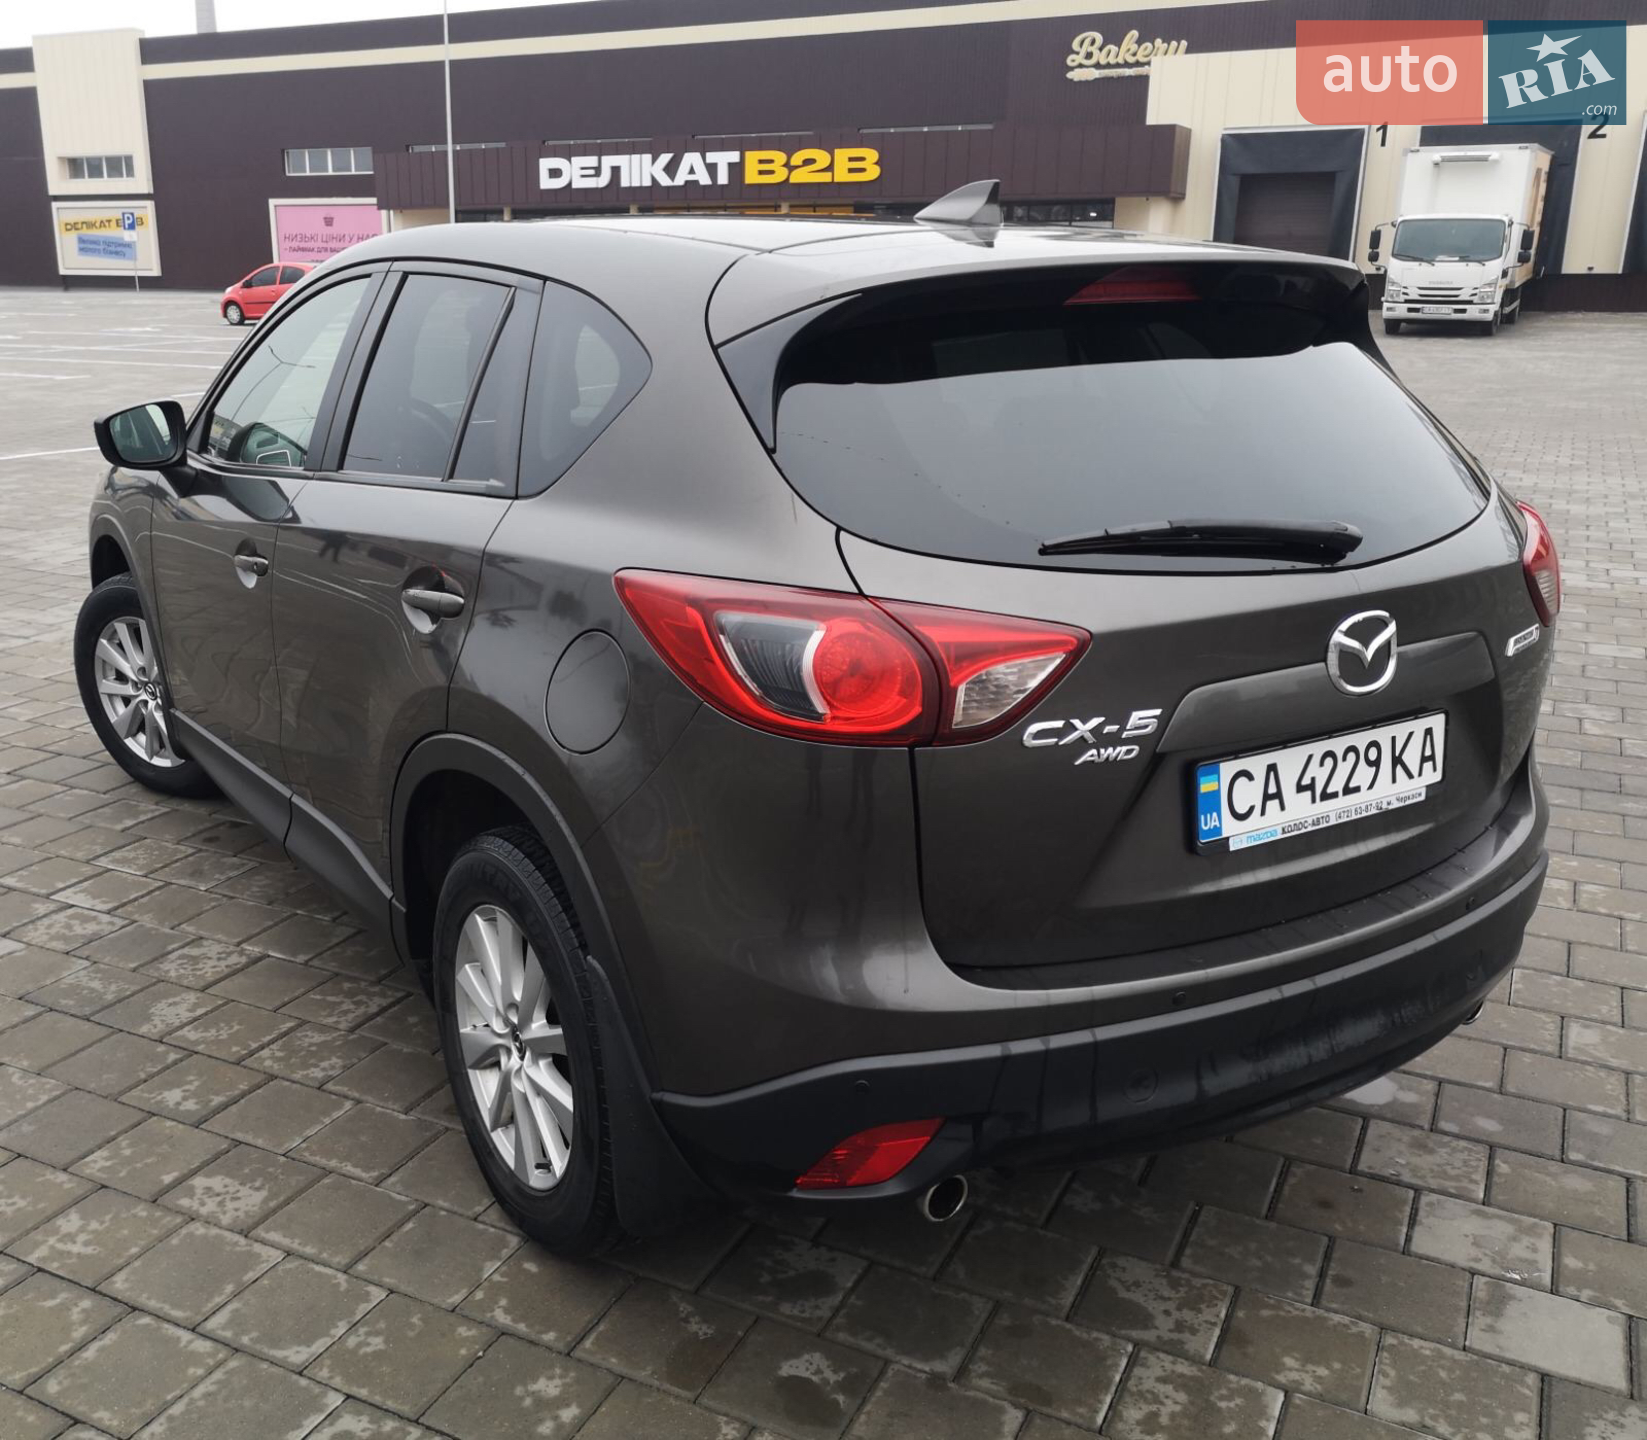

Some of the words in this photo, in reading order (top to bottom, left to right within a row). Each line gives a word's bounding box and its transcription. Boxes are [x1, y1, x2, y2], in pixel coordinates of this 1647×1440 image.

[1375, 121, 1389, 147] 1
[1587, 112, 1610, 140] 2
[744, 147, 881, 184] B2B
[115, 216, 145, 228] BB
[123, 213, 133, 229] P
[283, 232, 319, 244] НИЗЬКІ
[321, 232, 346, 245] ЦІНИ
[348, 233, 355, 243] У
[1022, 708, 1163, 748] CX-5
[1073, 744, 1140, 766] AWD
[1227, 762, 1286, 822] CA
[1295, 739, 1383, 805] 4229
[1390, 726, 1438, 784] KA
[1200, 812, 1221, 831] UA
[1281, 814, 1331, 835] КОЛОС-АВТО
[1335, 808, 1353, 822] (472)
[1354, 800, 1384, 816] 63-87-92
[1395, 791, 1423, 804] Черкаси
